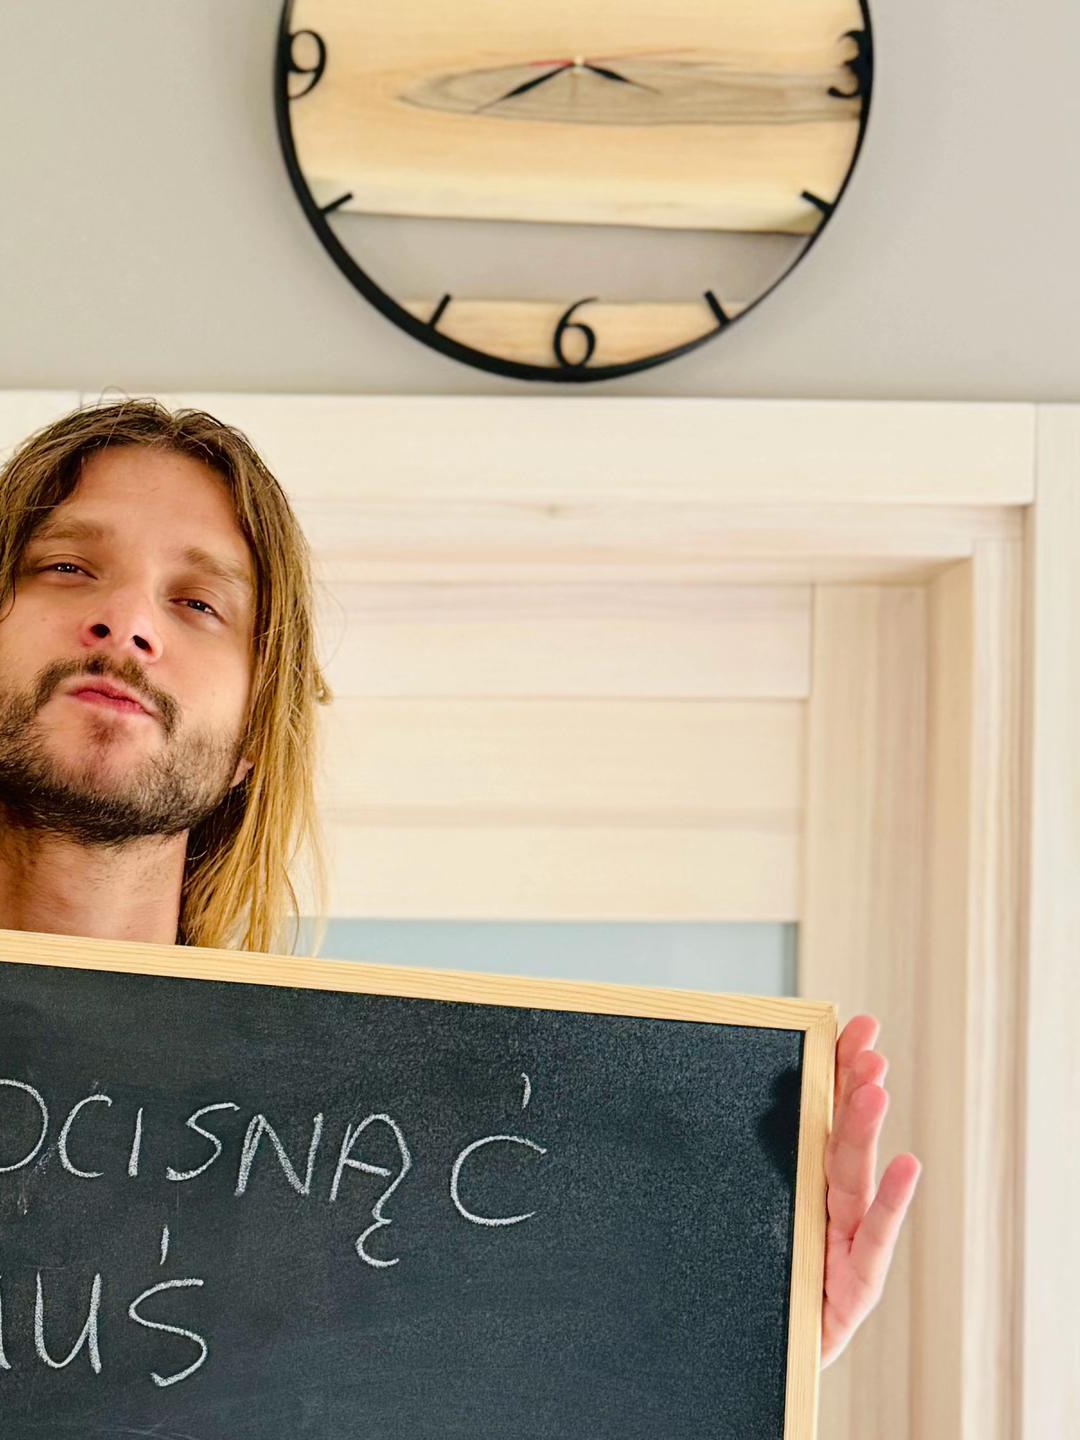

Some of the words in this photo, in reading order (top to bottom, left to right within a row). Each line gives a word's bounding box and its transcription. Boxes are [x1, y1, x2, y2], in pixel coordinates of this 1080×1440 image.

[287, 29, 328, 100] 9
[827, 29, 867, 99] 3
[552, 297, 600, 370] 6
